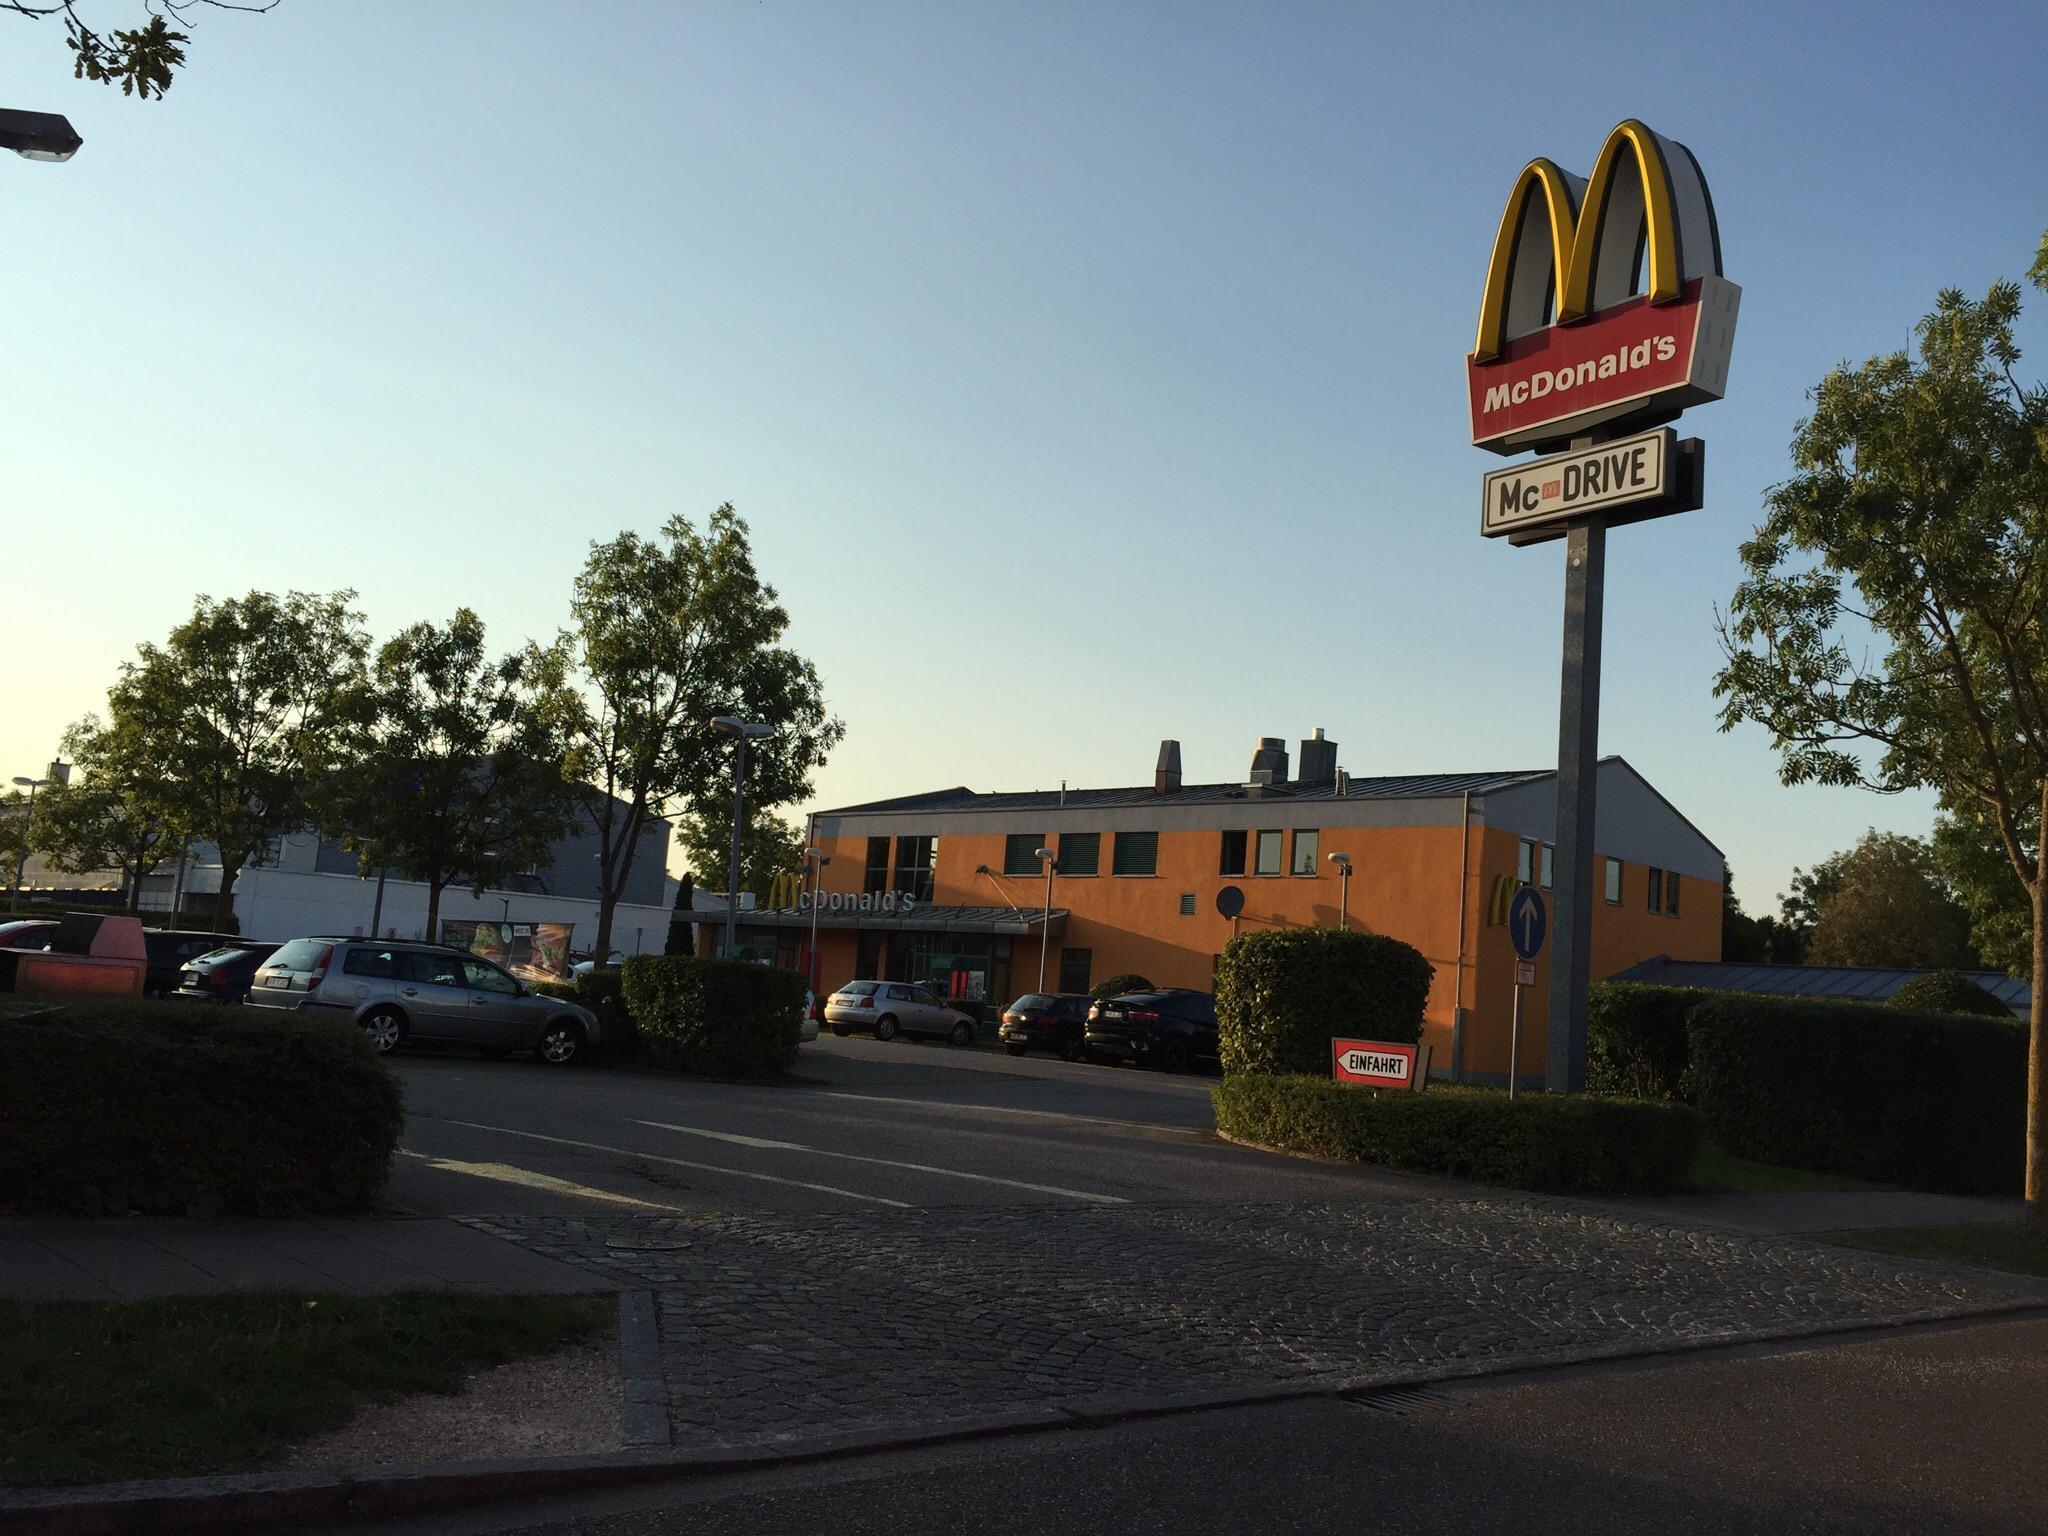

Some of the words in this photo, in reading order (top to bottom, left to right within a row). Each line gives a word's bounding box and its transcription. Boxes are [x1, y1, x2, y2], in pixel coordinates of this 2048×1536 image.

[1483, 335, 1677, 413] McDonald's
[1500, 478, 1539, 516] Mc
[1563, 447, 1646, 501] DRIVE
[1349, 1054, 1403, 1075] EINFAHRT
